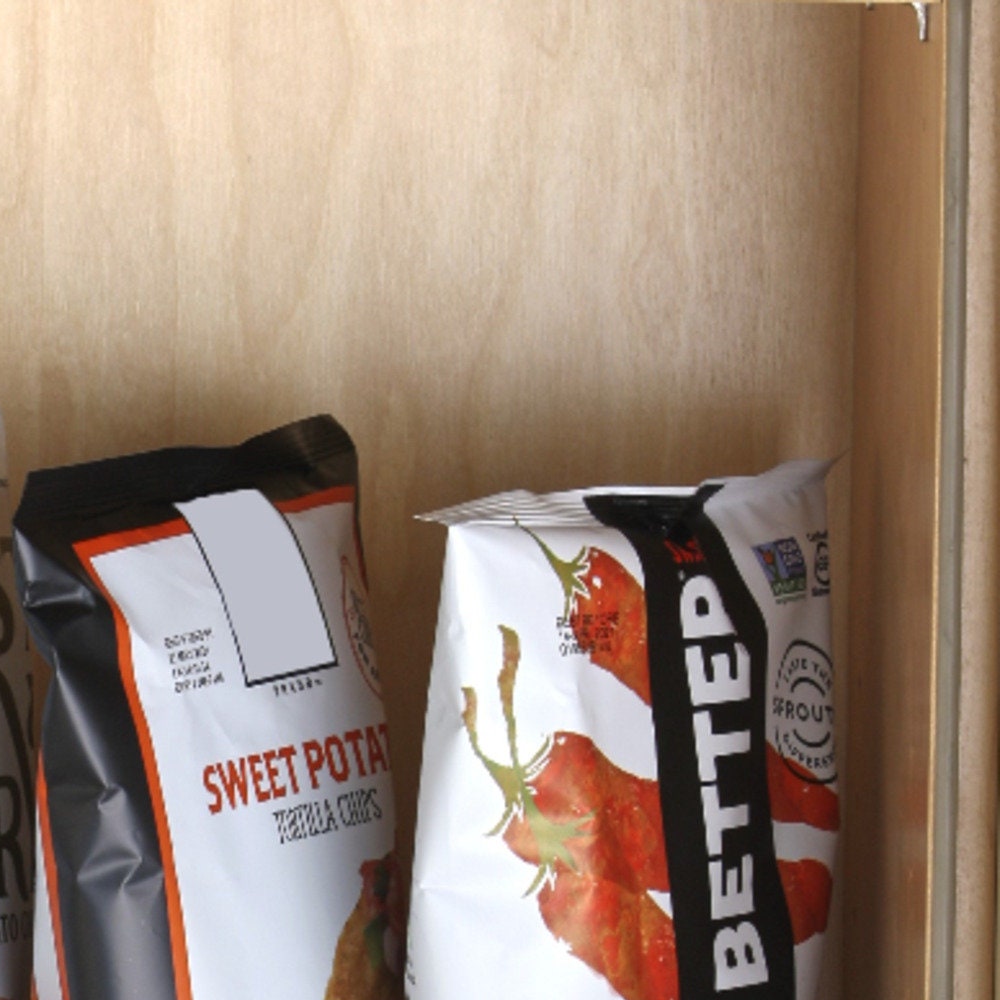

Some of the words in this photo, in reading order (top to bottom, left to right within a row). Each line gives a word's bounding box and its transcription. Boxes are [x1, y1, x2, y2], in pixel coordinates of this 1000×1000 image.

[202, 744, 300, 816] SWEET
[302, 723, 391, 790] POTAT
[337, 788, 383, 827] CHIPS
